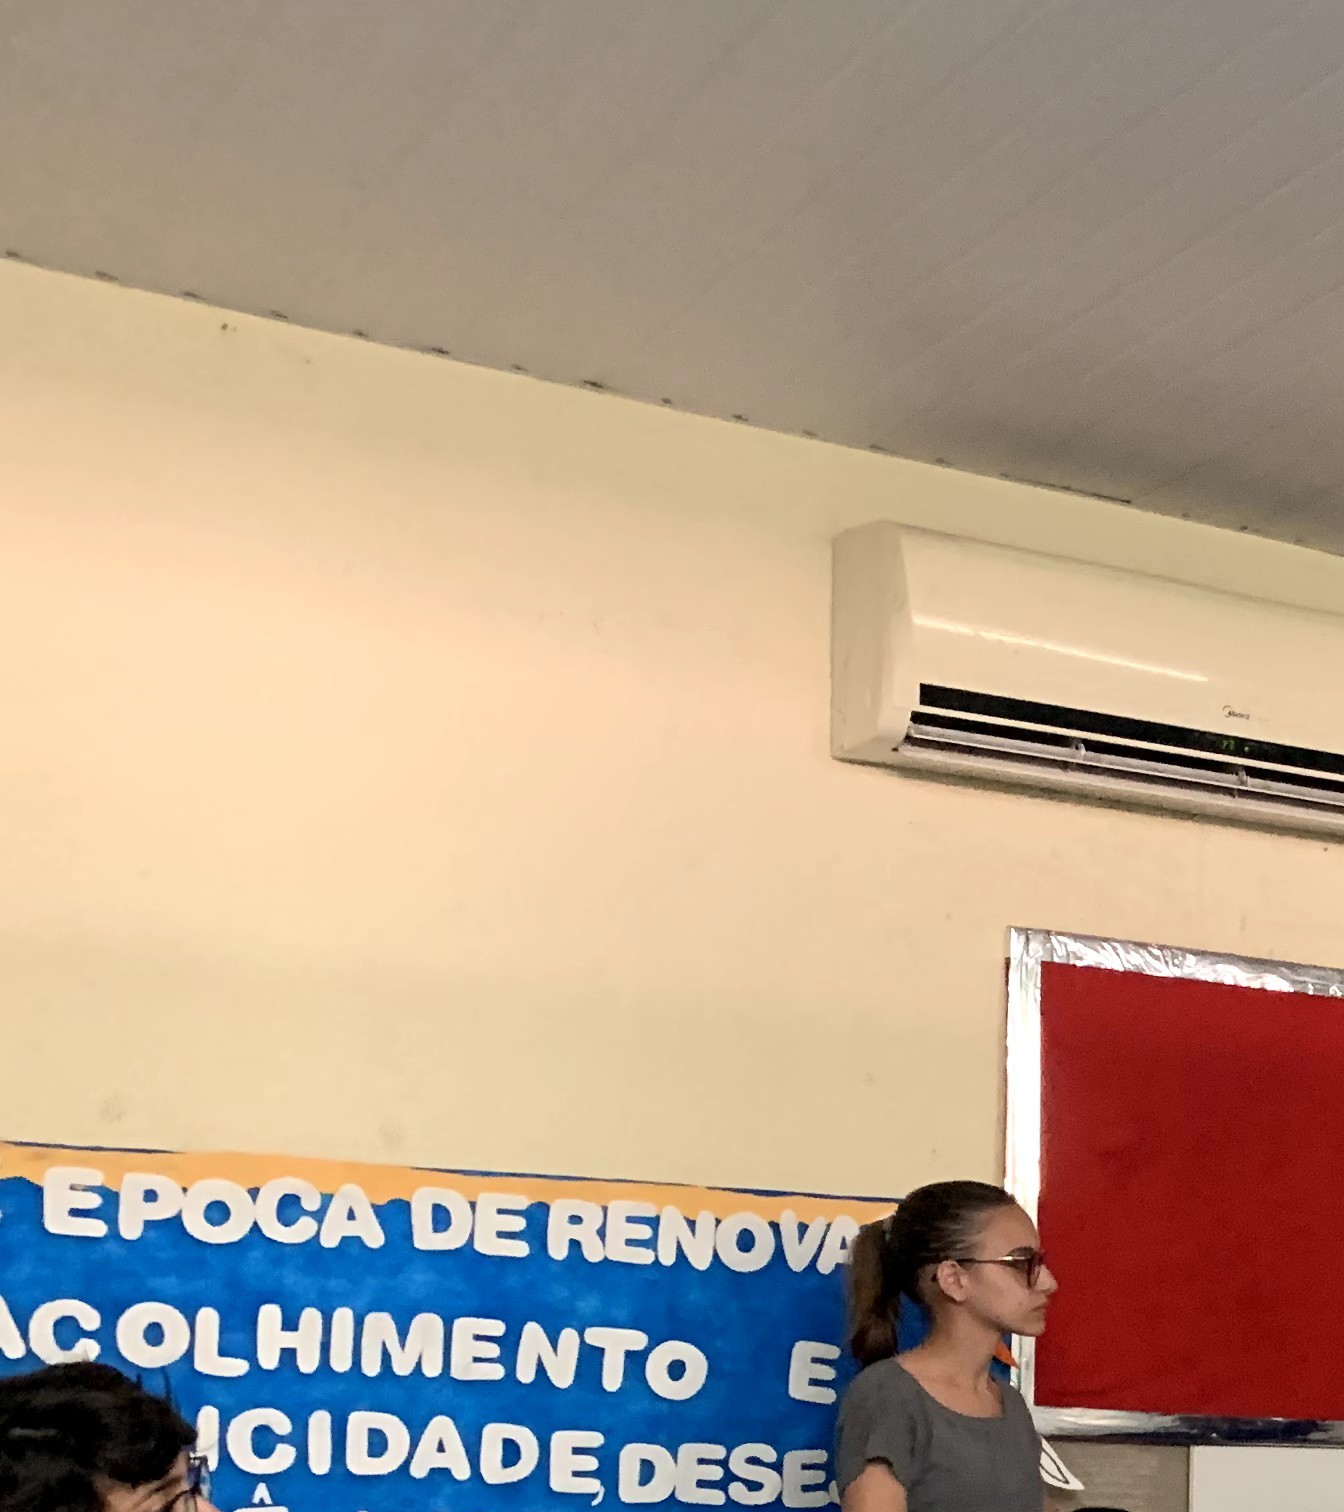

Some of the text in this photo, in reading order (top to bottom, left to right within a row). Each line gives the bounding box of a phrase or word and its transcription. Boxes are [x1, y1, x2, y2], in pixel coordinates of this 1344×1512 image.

[43, 1166, 385, 1250] EPOCA
[411, 1187, 530, 1259] DE
[788, 1340, 842, 1404] E
[618, 1442, 842, 1508] DESE
